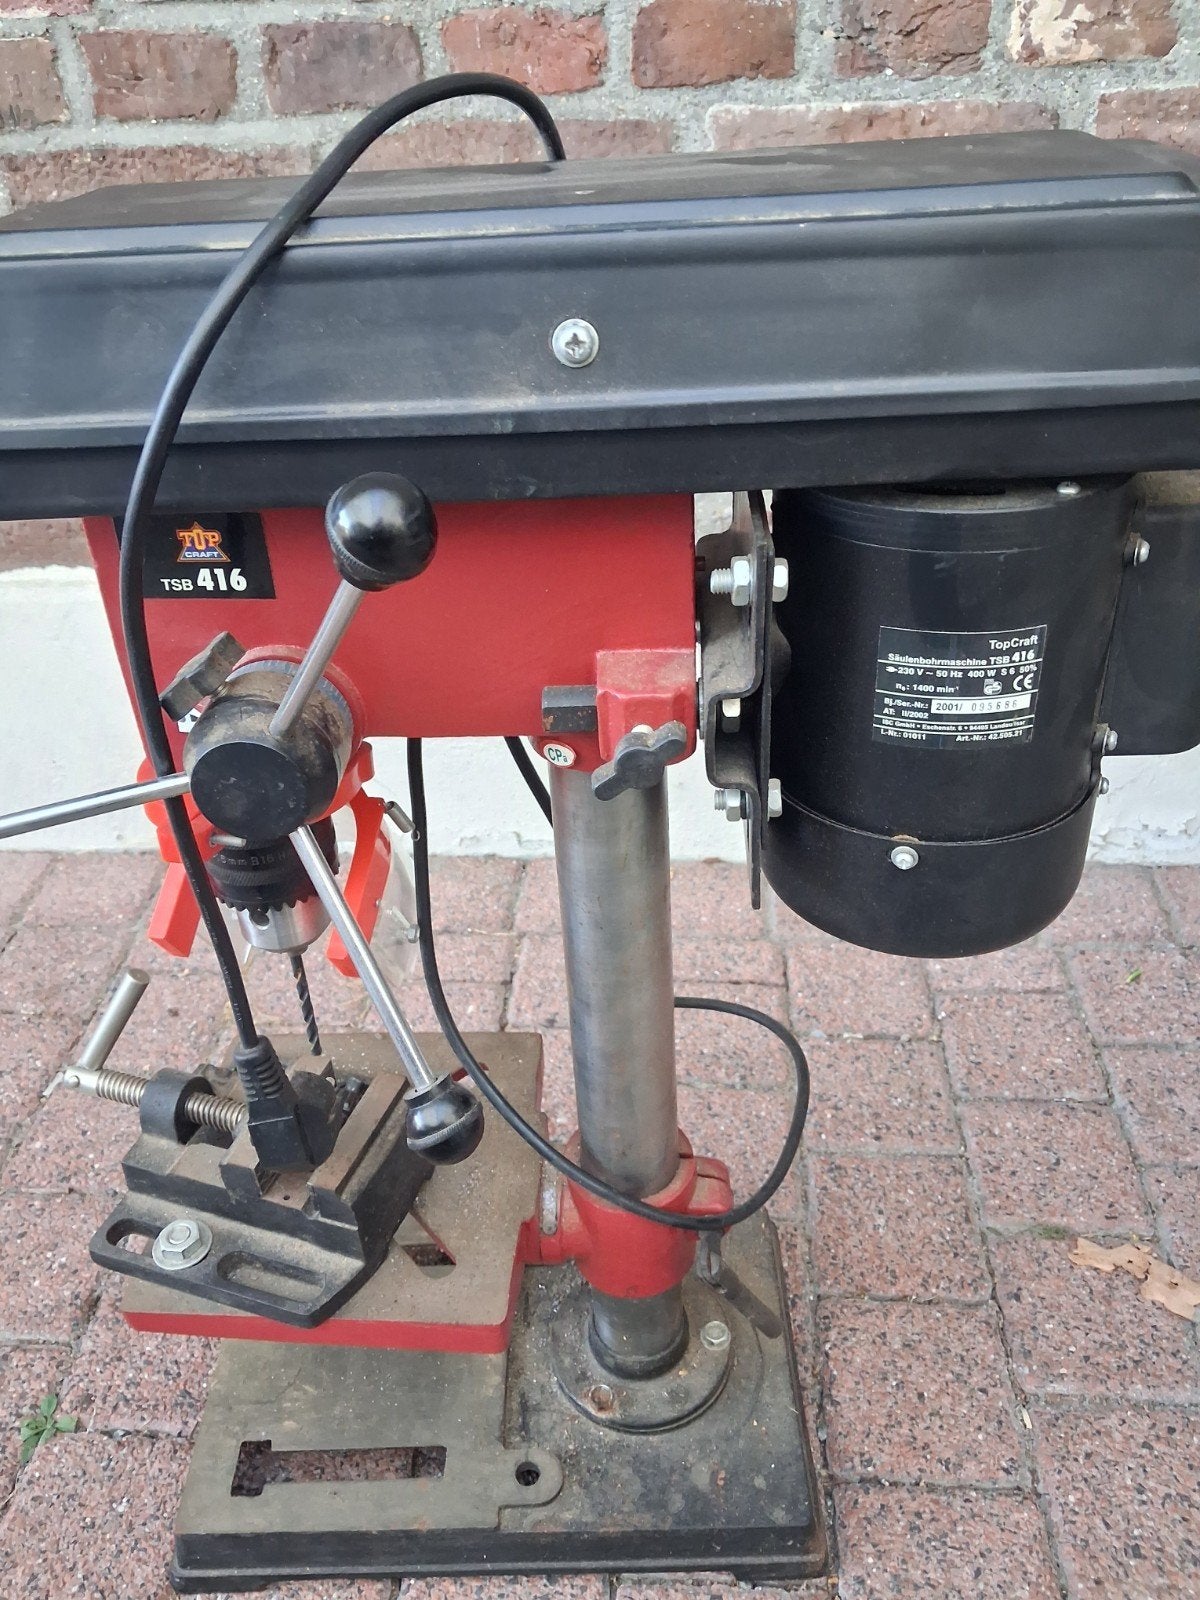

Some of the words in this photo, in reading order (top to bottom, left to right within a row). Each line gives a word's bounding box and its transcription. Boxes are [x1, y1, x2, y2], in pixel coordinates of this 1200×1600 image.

[177, 527, 221, 550] TOP
[160, 578, 194, 591] TSB
[196, 568, 248, 591] 416
[988, 634, 1038, 651] TopCraft
[887, 652, 988, 666] Säulenbohrmaschine
[989, 655, 1010, 665] TSB
[1011, 649, 1035, 662] 416
[897, 666, 915, 675] 230
[916, 668, 924, 676] V
[935, 669, 948, 678] 50
[949, 670, 964, 678] Hz
[967, 670, 985, 678] 400
[986, 669, 997, 677] W
[1019, 664, 1038, 673] 50%
[912, 684, 935, 692] 1400
[883, 707, 896, 715] AT:
[894, 720, 916, 729] GmbH
